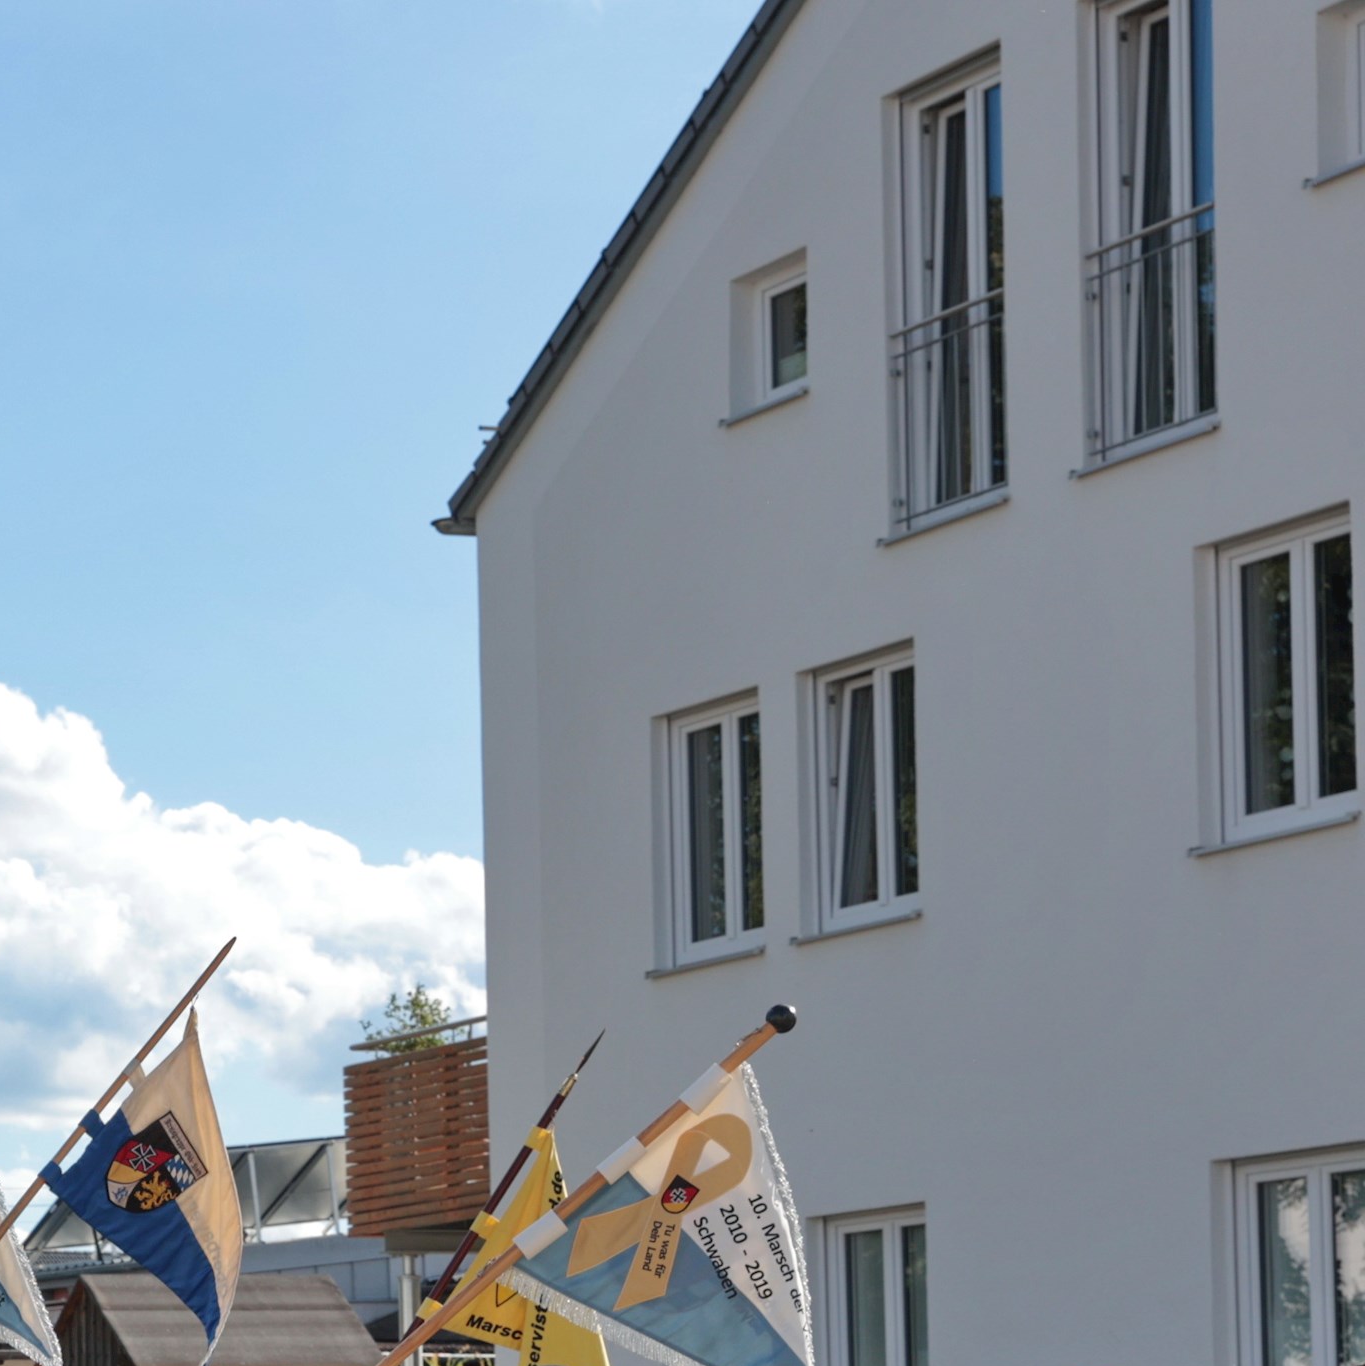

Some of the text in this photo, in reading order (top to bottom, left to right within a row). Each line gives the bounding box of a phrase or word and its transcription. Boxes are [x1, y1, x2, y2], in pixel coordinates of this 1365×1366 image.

[642, 1220, 663, 1272] Dein Land
[654, 1223, 676, 1279] Tu was für
[693, 1215, 738, 1300] Schwaben
[719, 1204, 748, 1245] 2010
[744, 1260, 773, 1300] 2019
[748, 1193, 805, 1315] 10. Marsch der
[465, 1313, 524, 1341] Marsc
